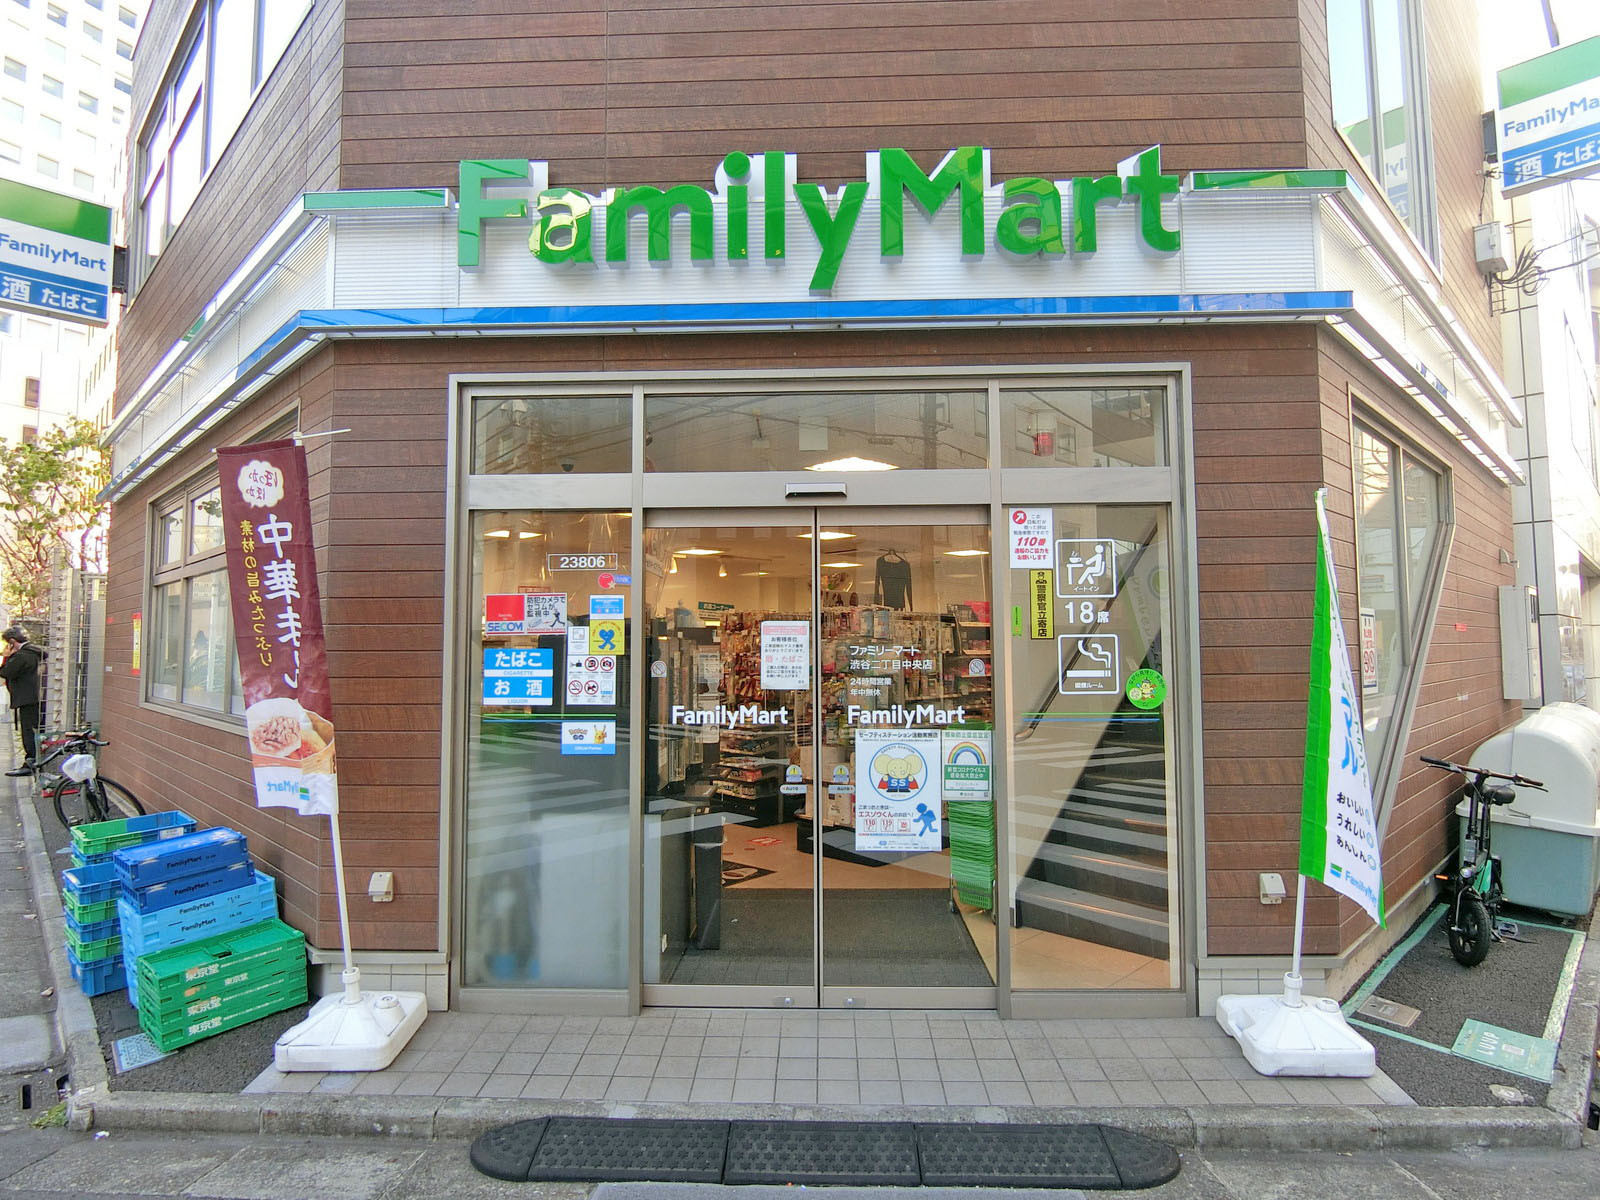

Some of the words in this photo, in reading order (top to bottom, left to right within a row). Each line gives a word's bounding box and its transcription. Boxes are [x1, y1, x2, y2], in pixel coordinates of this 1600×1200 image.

[1514, 154, 1543, 183] 酒
[1554, 139, 1600, 169] たば
[457, 144, 1181, 293] FamilyMart
[0, 232, 107, 271] FamilyMart
[1, 276, 31, 302] 酒
[41, 287, 97, 314] たばこ
[560, 556, 606, 568] 23806
[1036, 584, 1048, 637] 警察官立寄店
[487, 622, 524, 632] SECOM
[495, 651, 543, 667] たばこ
[849, 645, 920, 656] ファミリーマート
[849, 659, 933, 670] 渋谷二丁目中央店
[850, 688, 882, 697] 年中無休
[672, 705, 788, 729] FamilyMart
[848, 705, 966, 729] FamilyMart
[166, 855, 202, 869] FamilyMart
[174, 880, 210, 896] FamilyMart
[179, 901, 215, 915] FamilyMart
[181, 917, 217, 932] FamilyMart
[185, 963, 220, 983] 東京堂
[188, 1015, 222, 1036] 東京堂
[1476, 1031, 1500, 1056] LUUP
